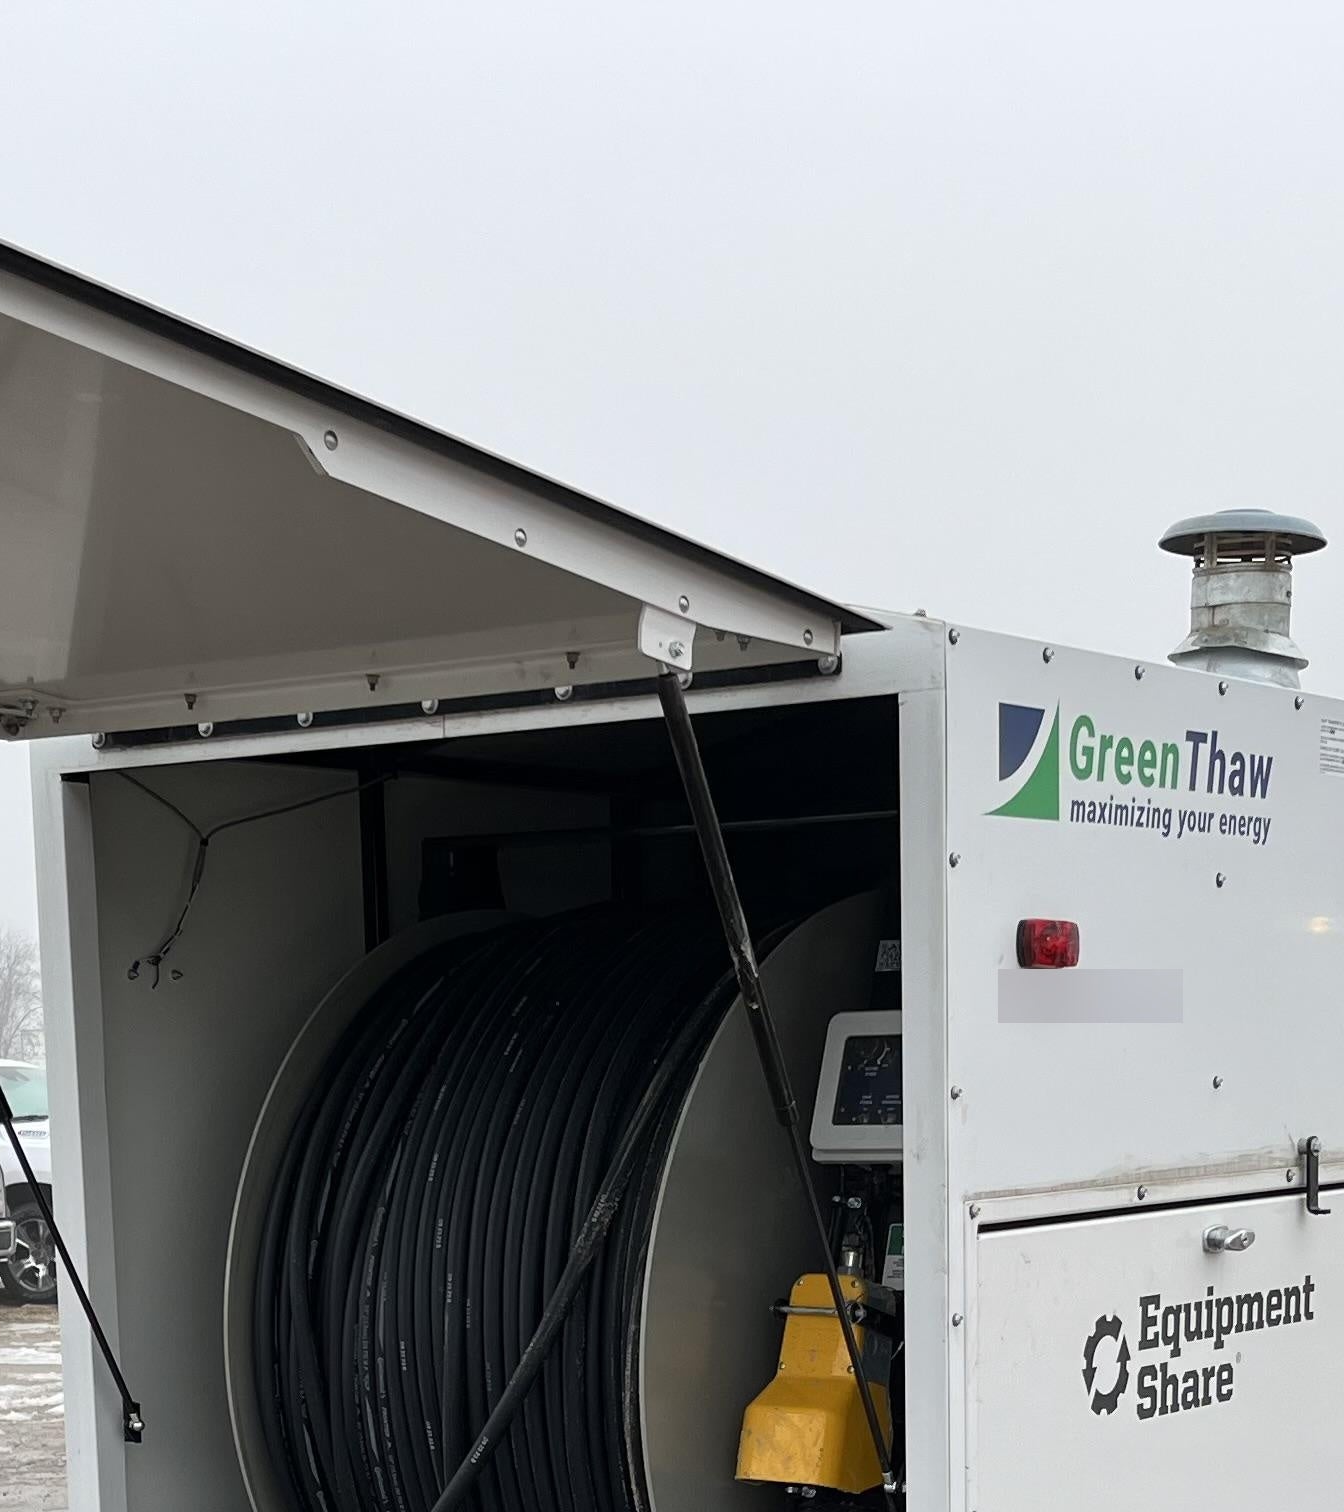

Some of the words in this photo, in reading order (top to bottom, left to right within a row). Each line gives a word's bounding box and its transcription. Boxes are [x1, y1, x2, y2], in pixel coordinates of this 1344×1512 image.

[1069, 795, 1172, 838] maximizing
[1177, 805, 1215, 839] your
[1219, 814, 1272, 846] energy
[1137, 1275, 1316, 1359] Equipment
[1136, 1362, 1235, 1421] Share
